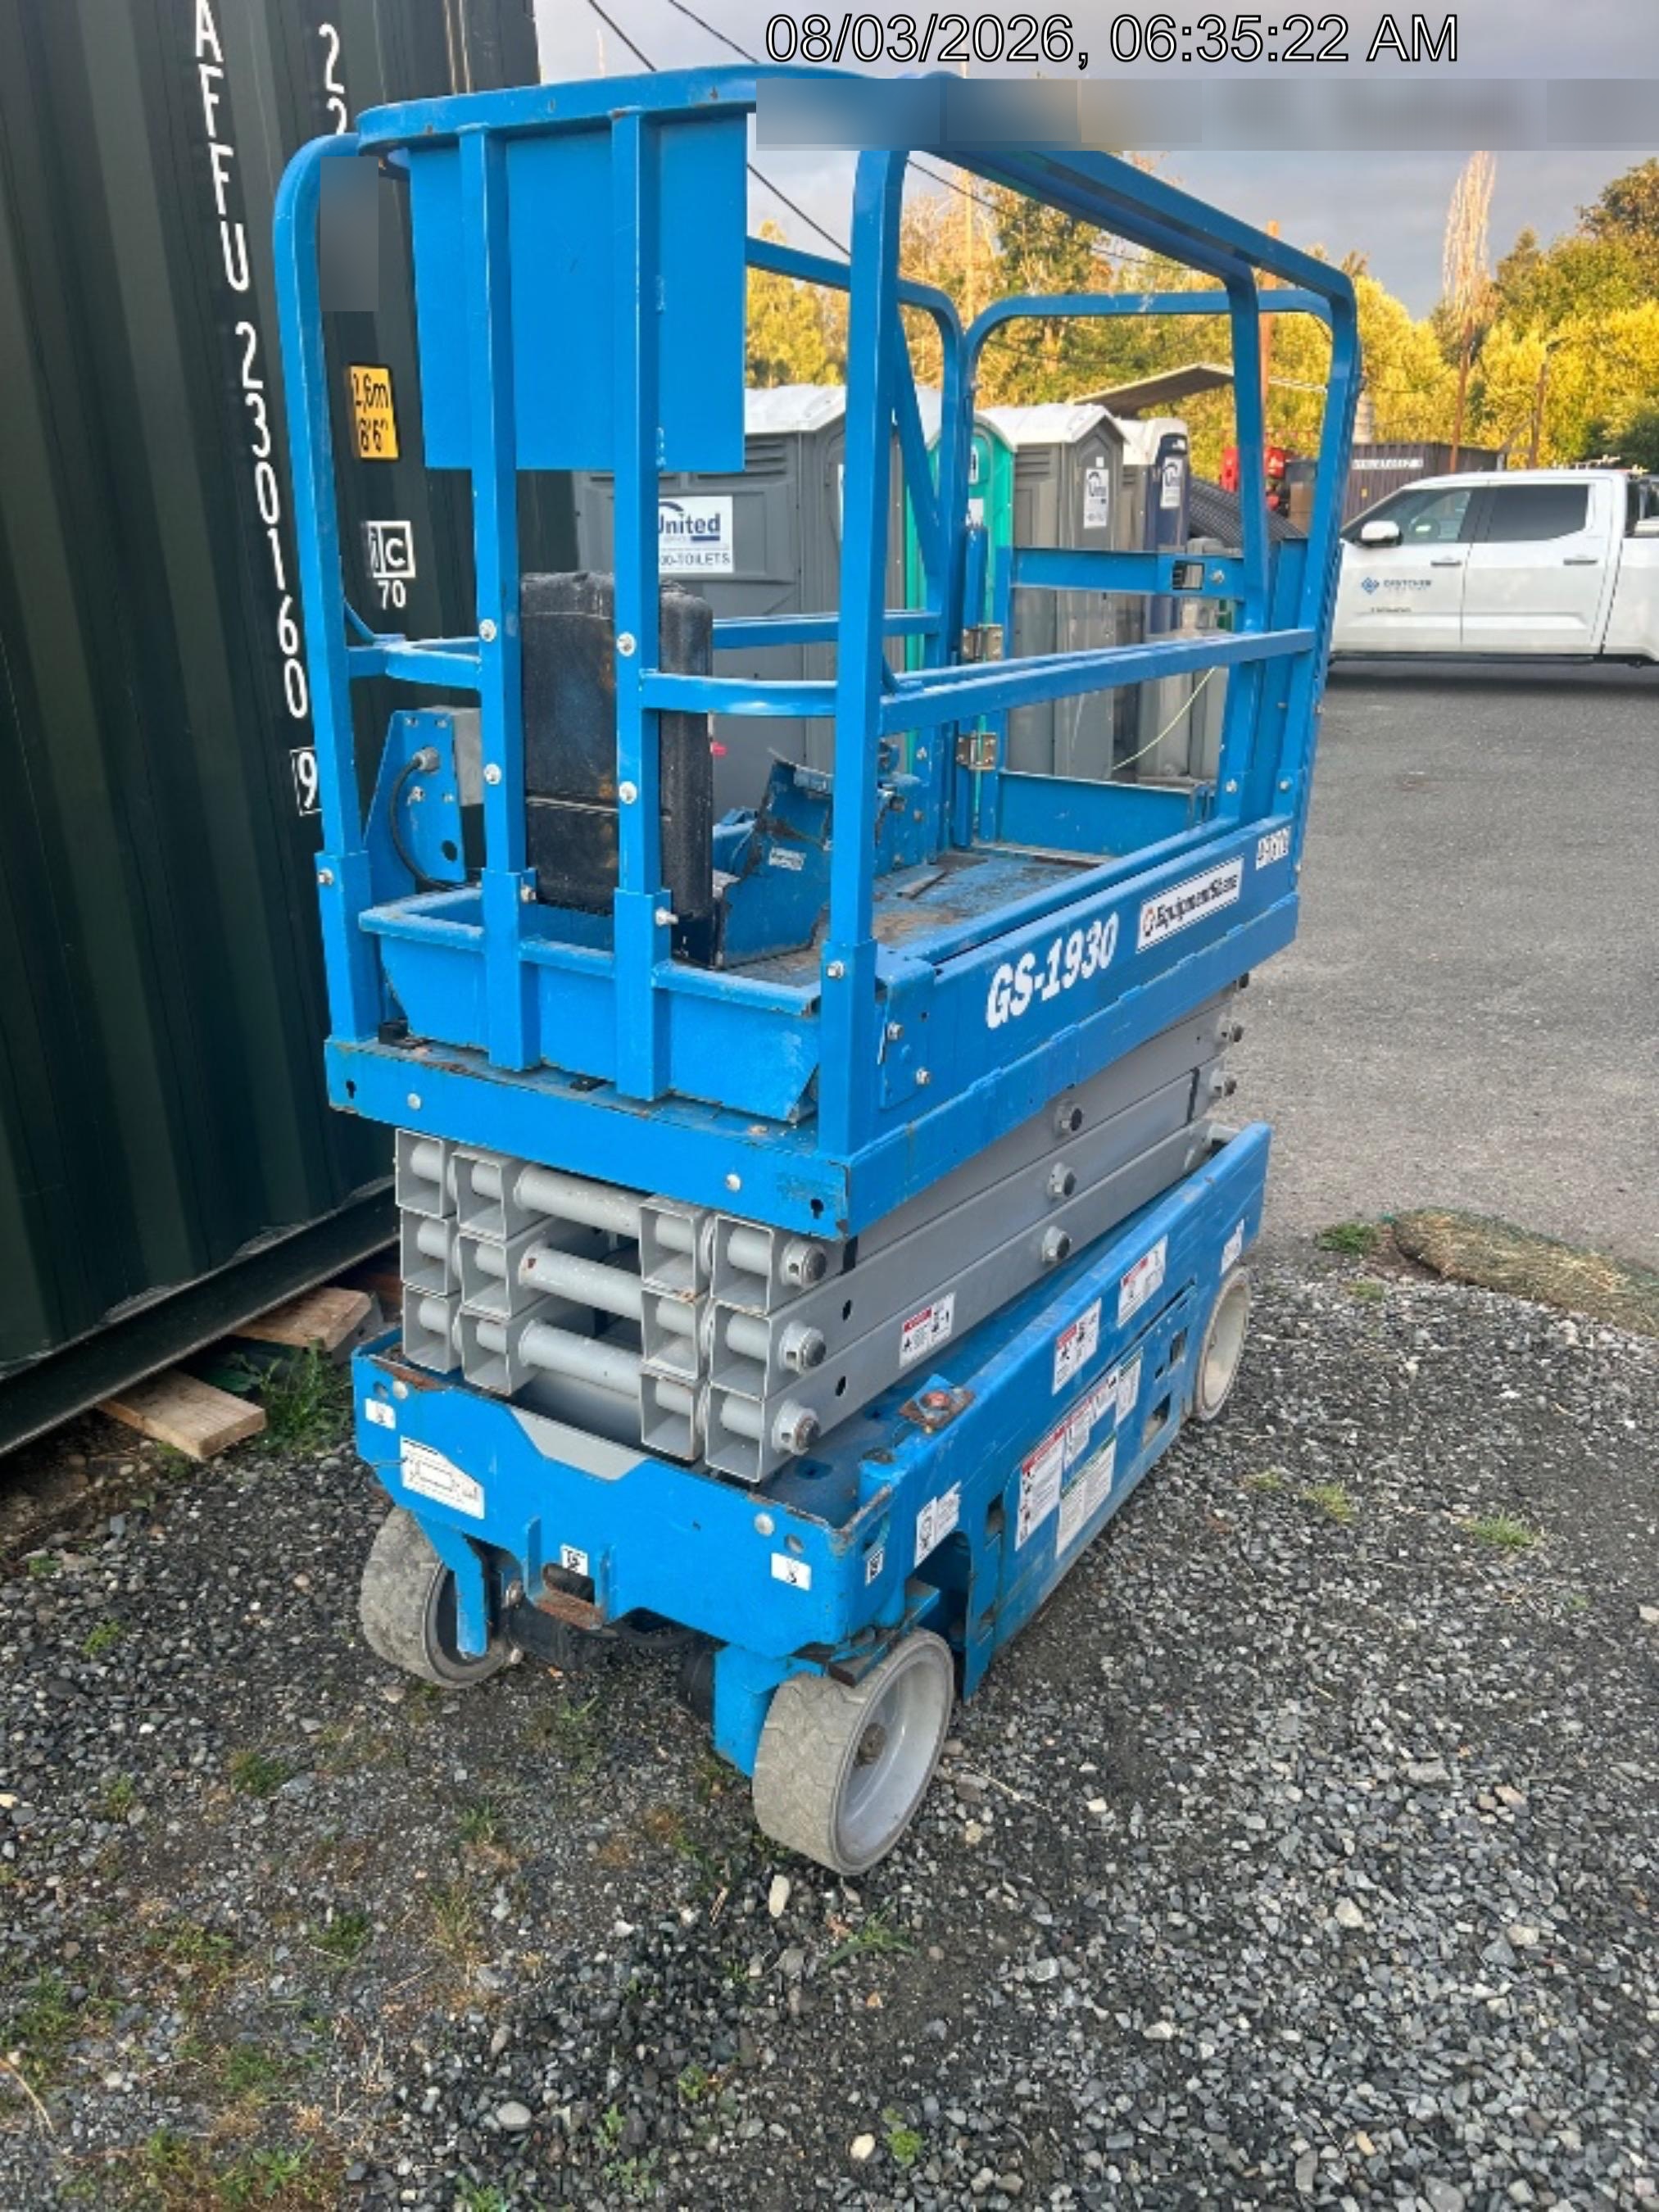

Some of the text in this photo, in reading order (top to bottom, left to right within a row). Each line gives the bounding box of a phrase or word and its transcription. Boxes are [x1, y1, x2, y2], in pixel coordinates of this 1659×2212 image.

[196, 0, 318, 808] AFFU 230160 9
[378, 578, 406, 610] 70
[986, 911, 1119, 1030] GS-1930
